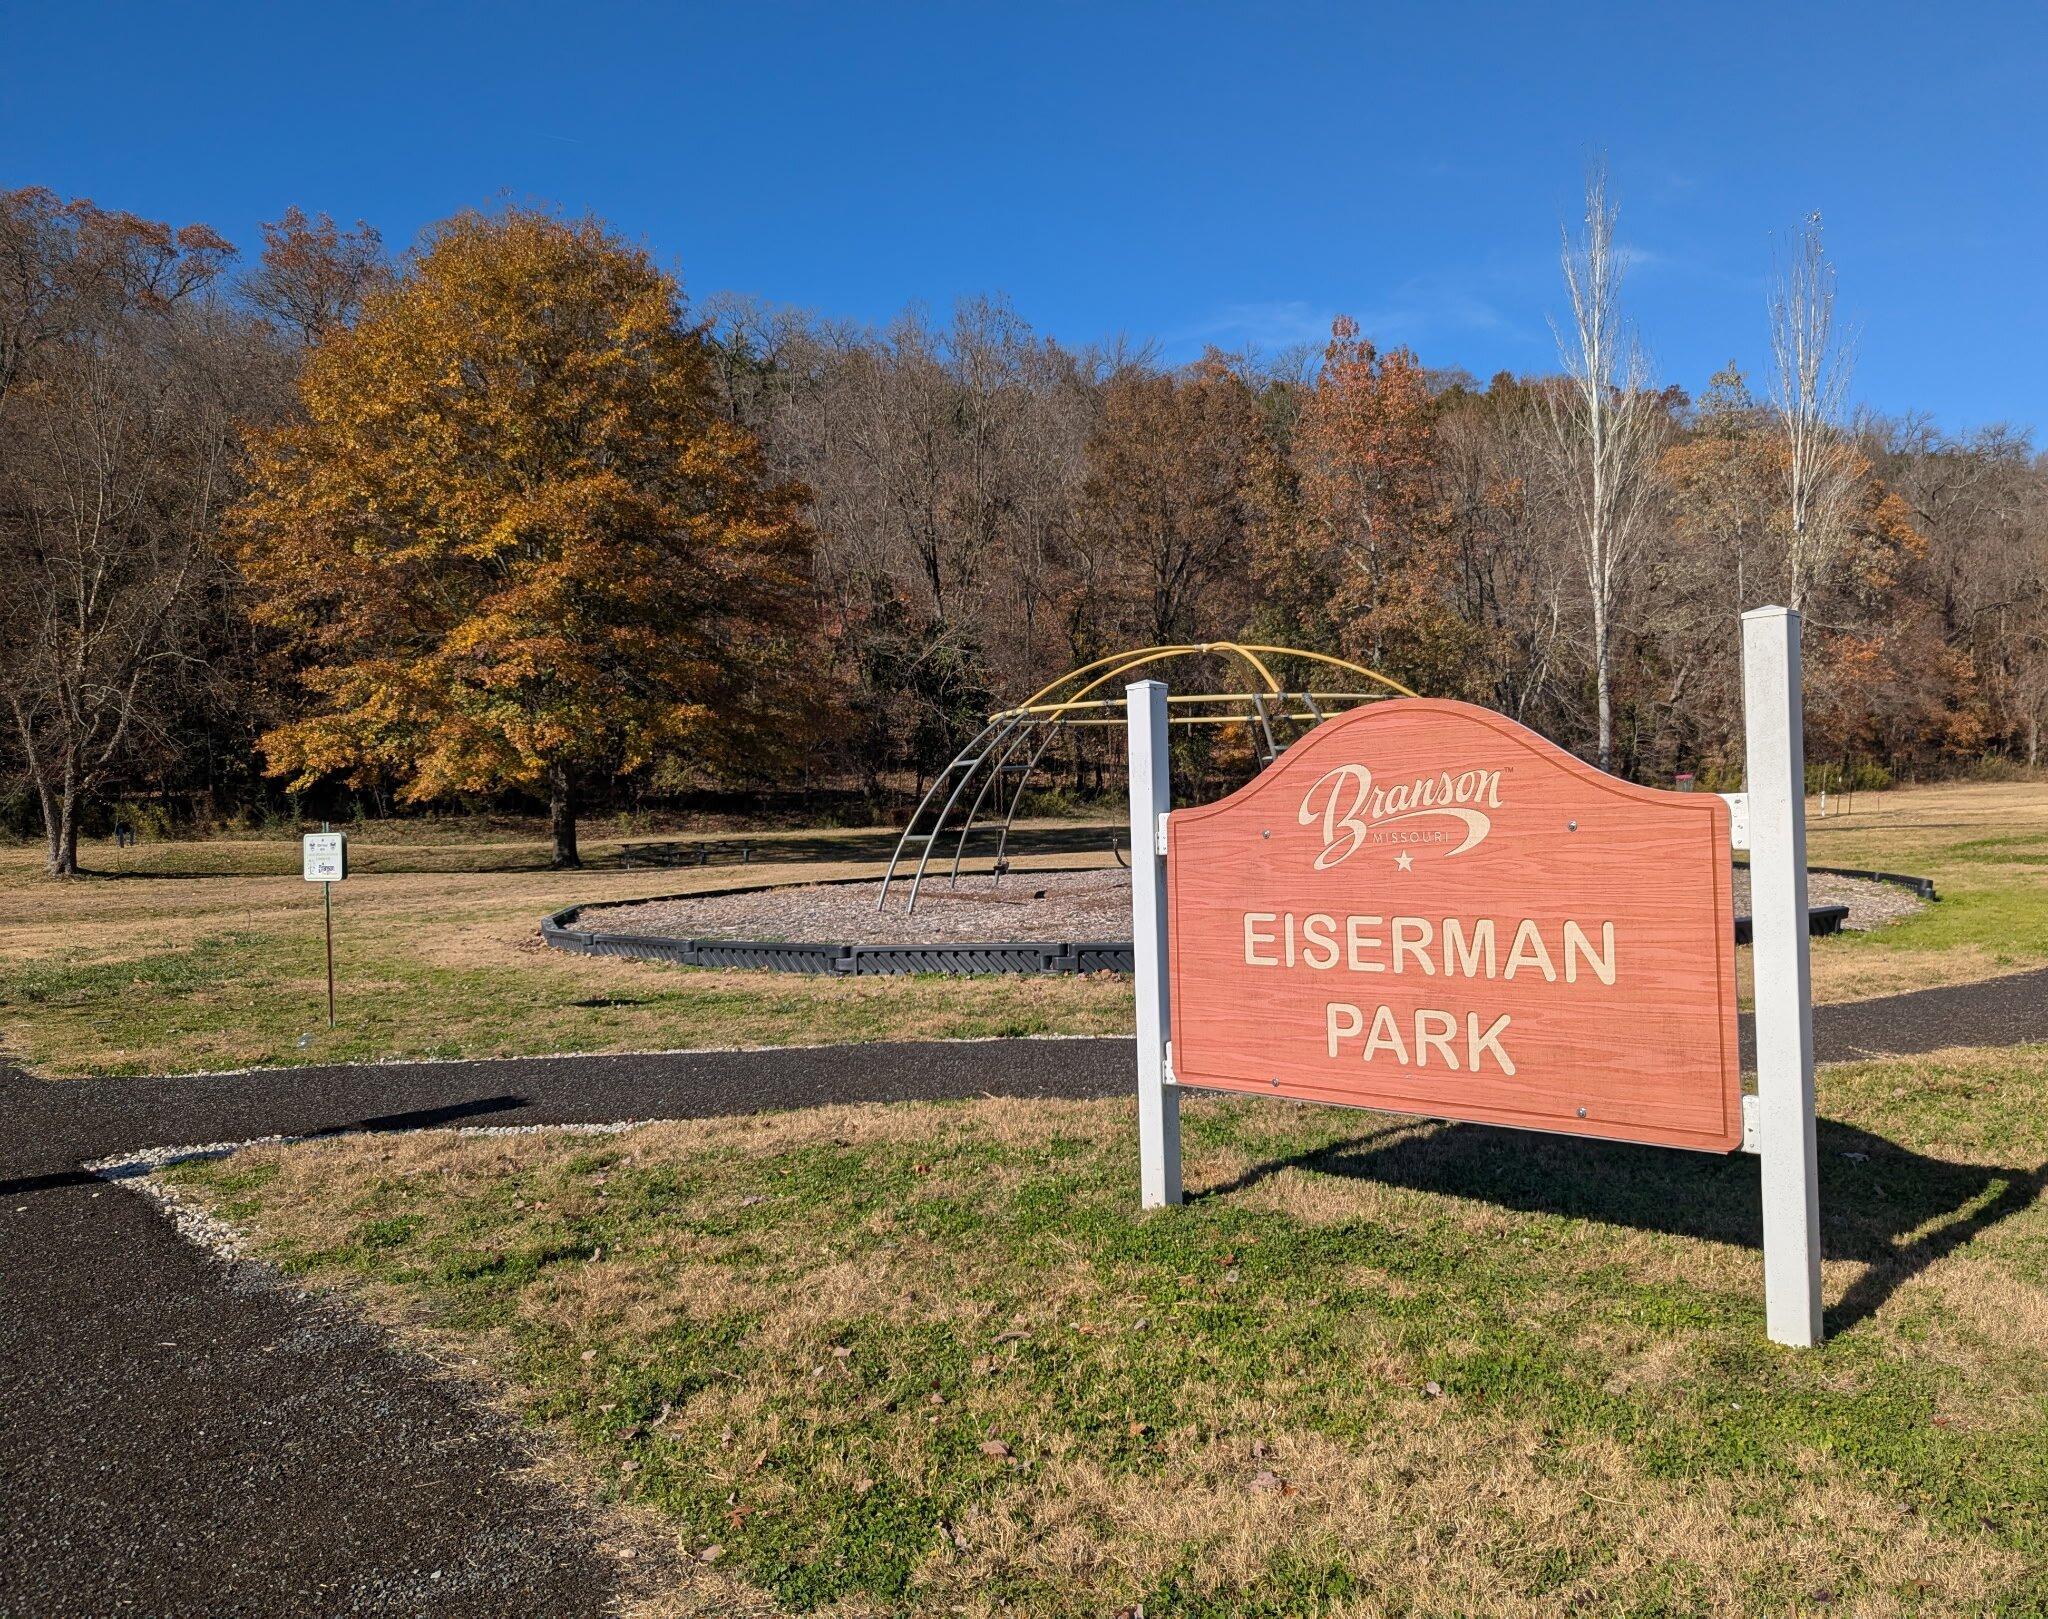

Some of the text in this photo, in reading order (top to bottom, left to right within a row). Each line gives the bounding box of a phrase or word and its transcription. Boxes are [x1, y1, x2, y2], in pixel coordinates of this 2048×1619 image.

[1298, 764, 1503, 870] Branson
[1373, 831, 1448, 843] MISSOURI
[1243, 912, 1616, 985] EISERMAN
[1326, 1002, 1516, 1076] PARK
